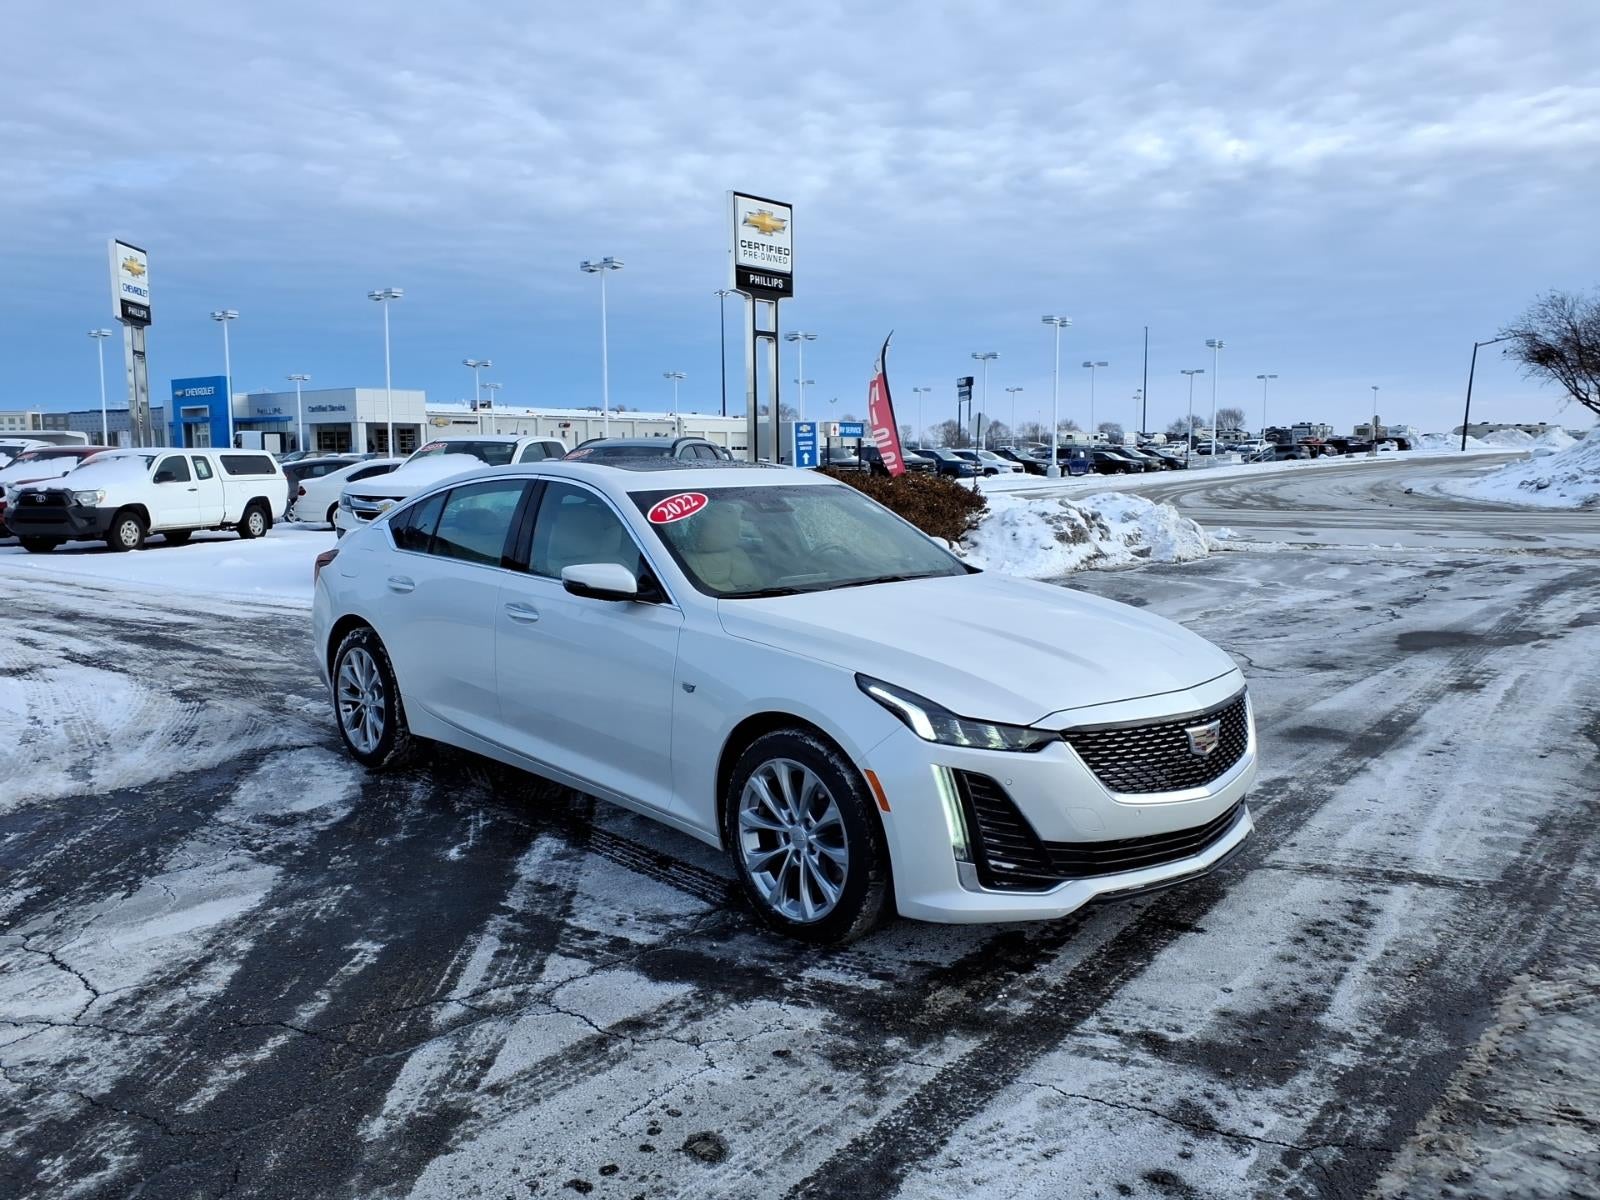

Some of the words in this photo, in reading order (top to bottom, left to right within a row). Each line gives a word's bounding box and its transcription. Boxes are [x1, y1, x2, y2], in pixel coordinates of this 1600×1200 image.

[740, 239, 790, 256] CERTIFIED
[743, 249, 788, 265] PRE-OWNED
[749, 274, 784, 289] PHILLIPS
[122, 282, 149, 298] CHEVROLET
[185, 386, 215, 397] CHEVROLET
[657, 495, 699, 520] 2022
